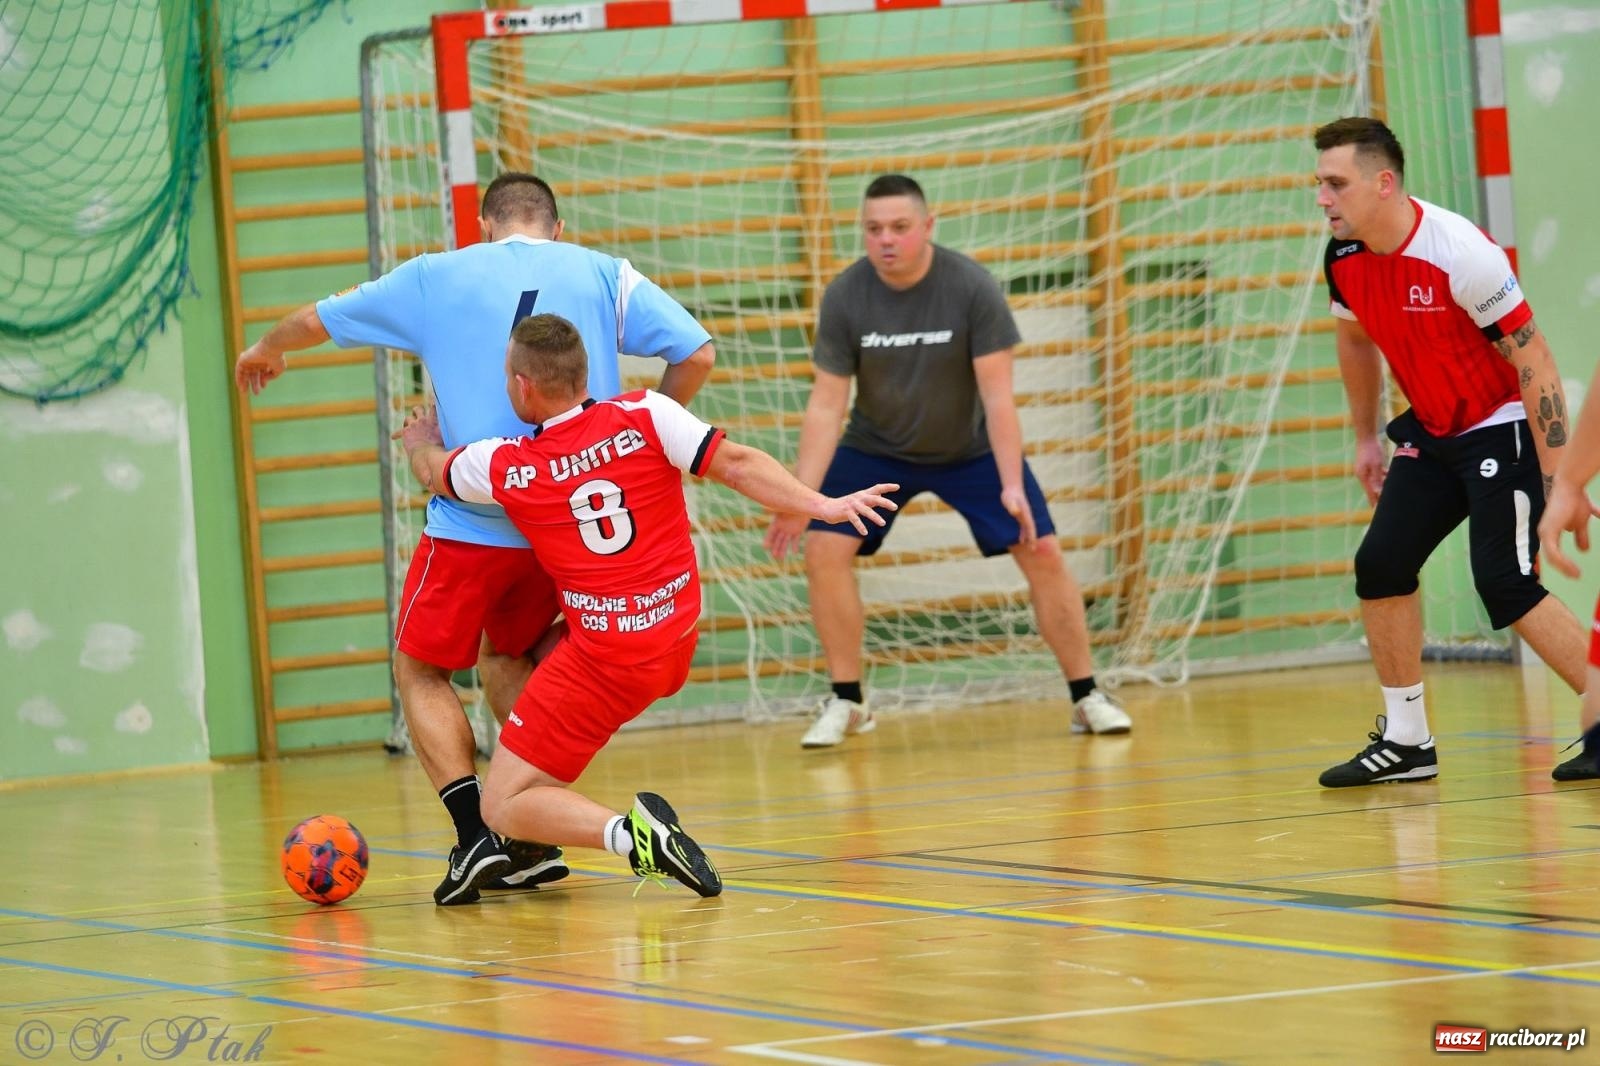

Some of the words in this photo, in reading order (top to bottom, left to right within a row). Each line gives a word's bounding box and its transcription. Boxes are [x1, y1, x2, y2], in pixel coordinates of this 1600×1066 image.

[861, 330, 953, 348] diverse
[503, 465, 537, 489] AP
[549, 428, 648, 483] UNITED
[568, 478, 637, 556] 8
[580, 612, 609, 632] COŚ
[617, 599, 675, 632] WIELKIEGO
